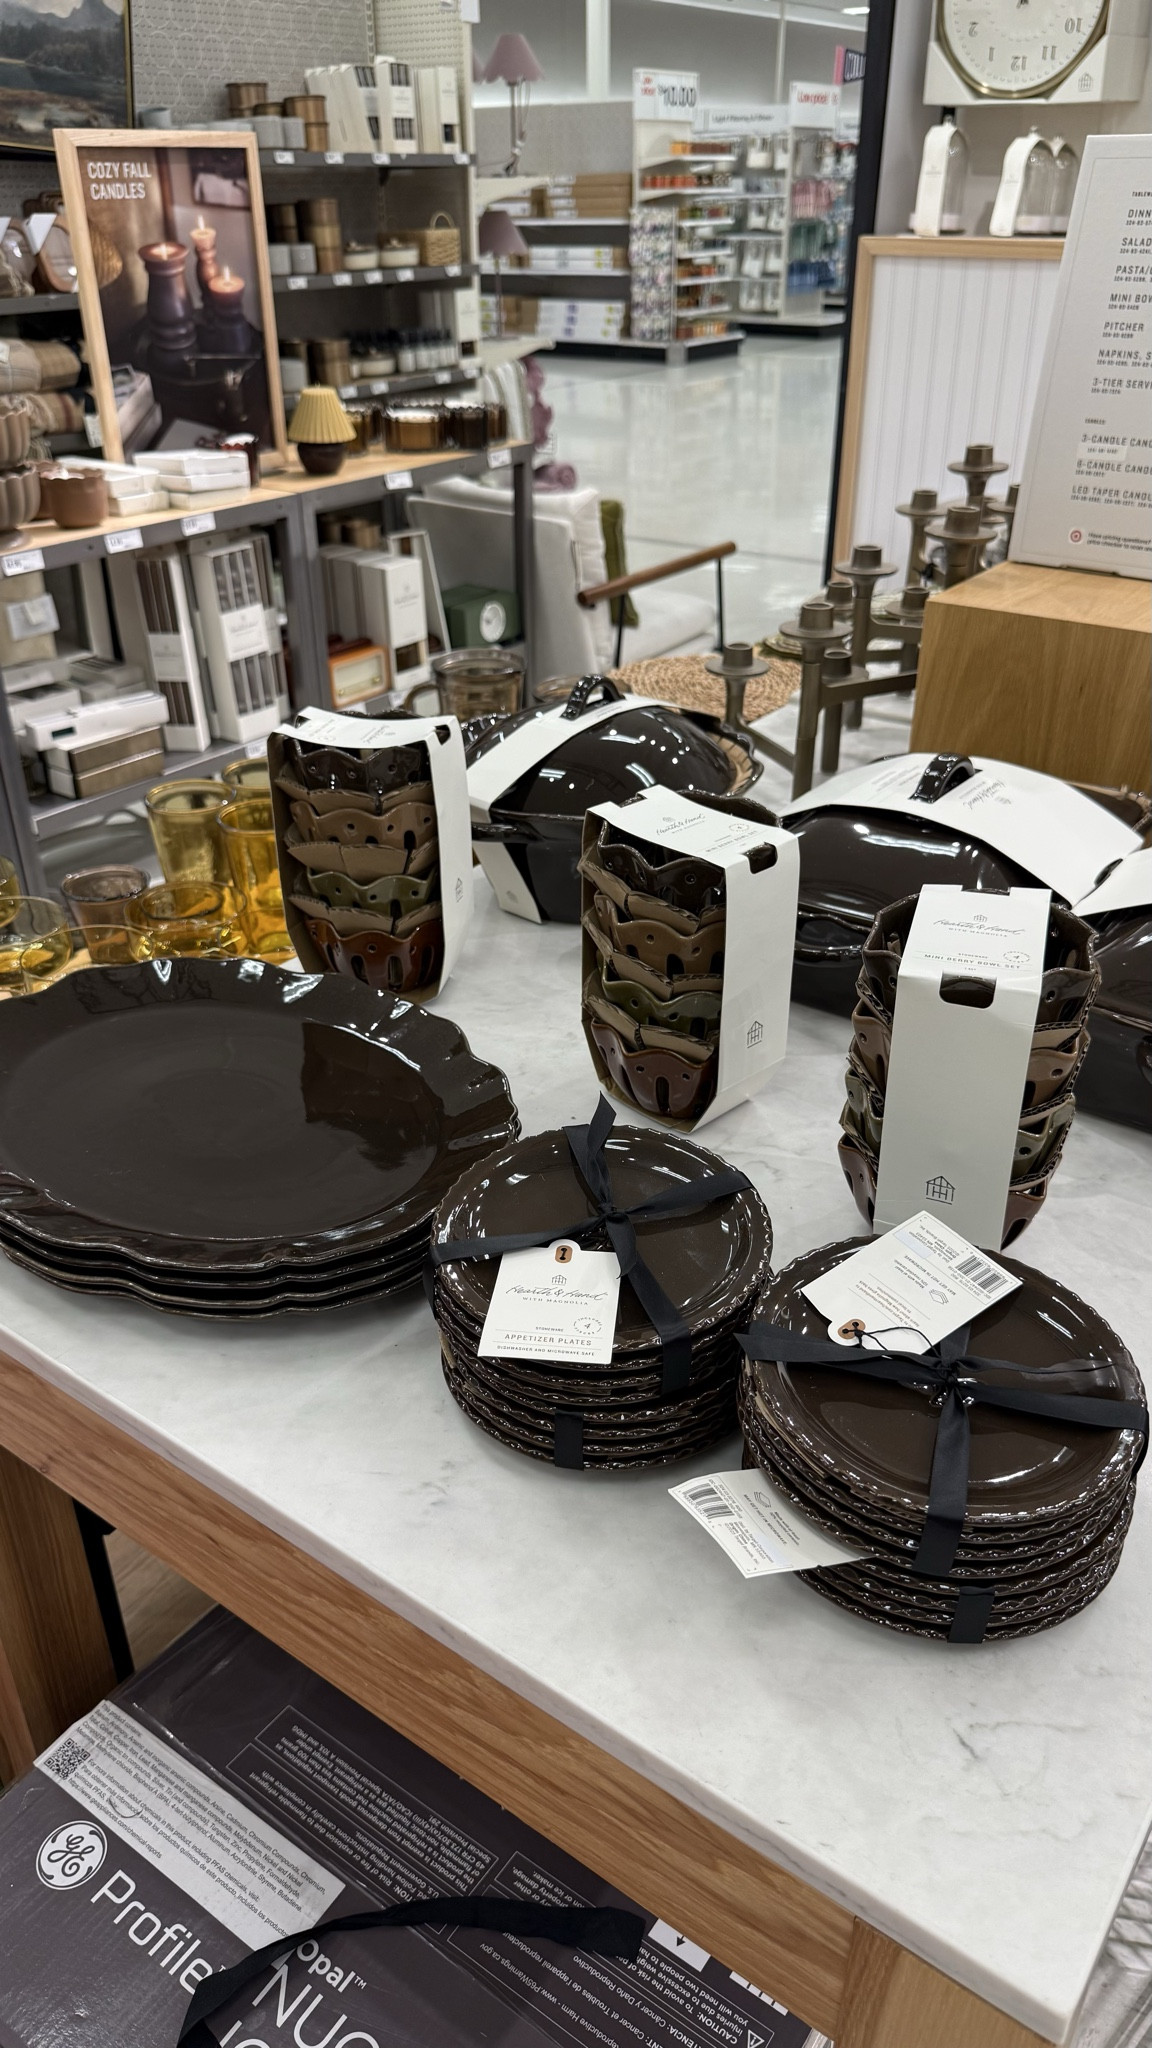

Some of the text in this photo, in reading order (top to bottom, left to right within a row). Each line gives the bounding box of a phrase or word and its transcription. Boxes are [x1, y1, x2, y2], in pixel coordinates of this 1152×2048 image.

[1064, 18, 1084, 34] 10
[1010, 56, 1028, 72] 12
[1042, 45, 1056, 60] 11
[87, 162, 151, 179] COZY FALL
[90, 182, 146, 200] CANDLES
[1128, 209, 1152, 218] DINN
[1121, 238, 1152, 247] SALAD
[1110, 293, 1132, 302] MINI
[1104, 322, 1144, 332] PITCHER
[1098, 349, 1142, 360] NAPKINS,
[1092, 378, 1122, 388] 3-TIER
[1072, 486, 1088, 494] LED
[1092, 487, 1120, 498] TAPER
[506, 1284, 608, 1301] Hearth & Hand
[504, 1334, 592, 1346] APPETIZER PLATES
[248, 1770, 280, 1798] refrigerant
[312, 1770, 340, 1794] transport
[276, 1793, 308, 1820] flammable
[337, 1789, 358, 1808] goods
[305, 1816, 315, 1826] to
[355, 1803, 388, 1830] dangerous
[260, 1770, 416, 1893] Follow handling instructions carefully in compliance with
[312, 1821, 326, 1834] due
[385, 1826, 402, 1842] from
[439, 1823, 468, 1847] Provision
[324, 1829, 355, 1856] explosion
[352, 1829, 391, 1861] Regulations.
[400, 1836, 425, 1858] exempt
[352, 1852, 361, 1860] or
[422, 1854, 431, 1863] is
[466, 1842, 492, 1863] Special
[210, 1859, 226, 1873] PFAS
[359, 1857, 372, 1870] fire
[369, 1866, 379, 1876] of
[388, 1857, 427, 1889] Government
[429, 1858, 456, 1881] product
[377, 1872, 393, 1886] Risk
[453, 1877, 468, 1891] This
[531, 1871, 553, 1889] maker.
[392, 1883, 416, 1904] TION:
[425, 1885, 439, 1898] U.S.
[512, 1879, 540, 1900] or other
[553, 1886, 564, 1896] ice
[540, 1958, 572, 1986] l'appareil
[570, 1953, 617, 1992] Reproductivo
[634, 1954, 658, 1975] weigh
[570, 1982, 582, 1993] de
[649, 1954, 748, 2026] you will need two people to
[656, 1971, 691, 1998] excessive
[580, 1989, 611, 2014] Troubles
[614, 1986, 635, 2005] Daño
[626, 1962, 738, 2044] CAUTION: To avoid the risk of
[634, 1999, 642, 2008] y
[690, 1995, 700, 2005] to
[252, 1963, 380, 2048] NU
[558, 2003, 579, 2022] Harm
[699, 2001, 716, 2016] due
[610, 2011, 619, 2021] et
[639, 2004, 666, 2028] Cáncer
[715, 2011, 744, 2035] injuries
[577, 2016, 620, 2048] eproductive
[618, 2017, 645, 2040] Cancer
[665, 2023, 701, 2048] TENCIA:
